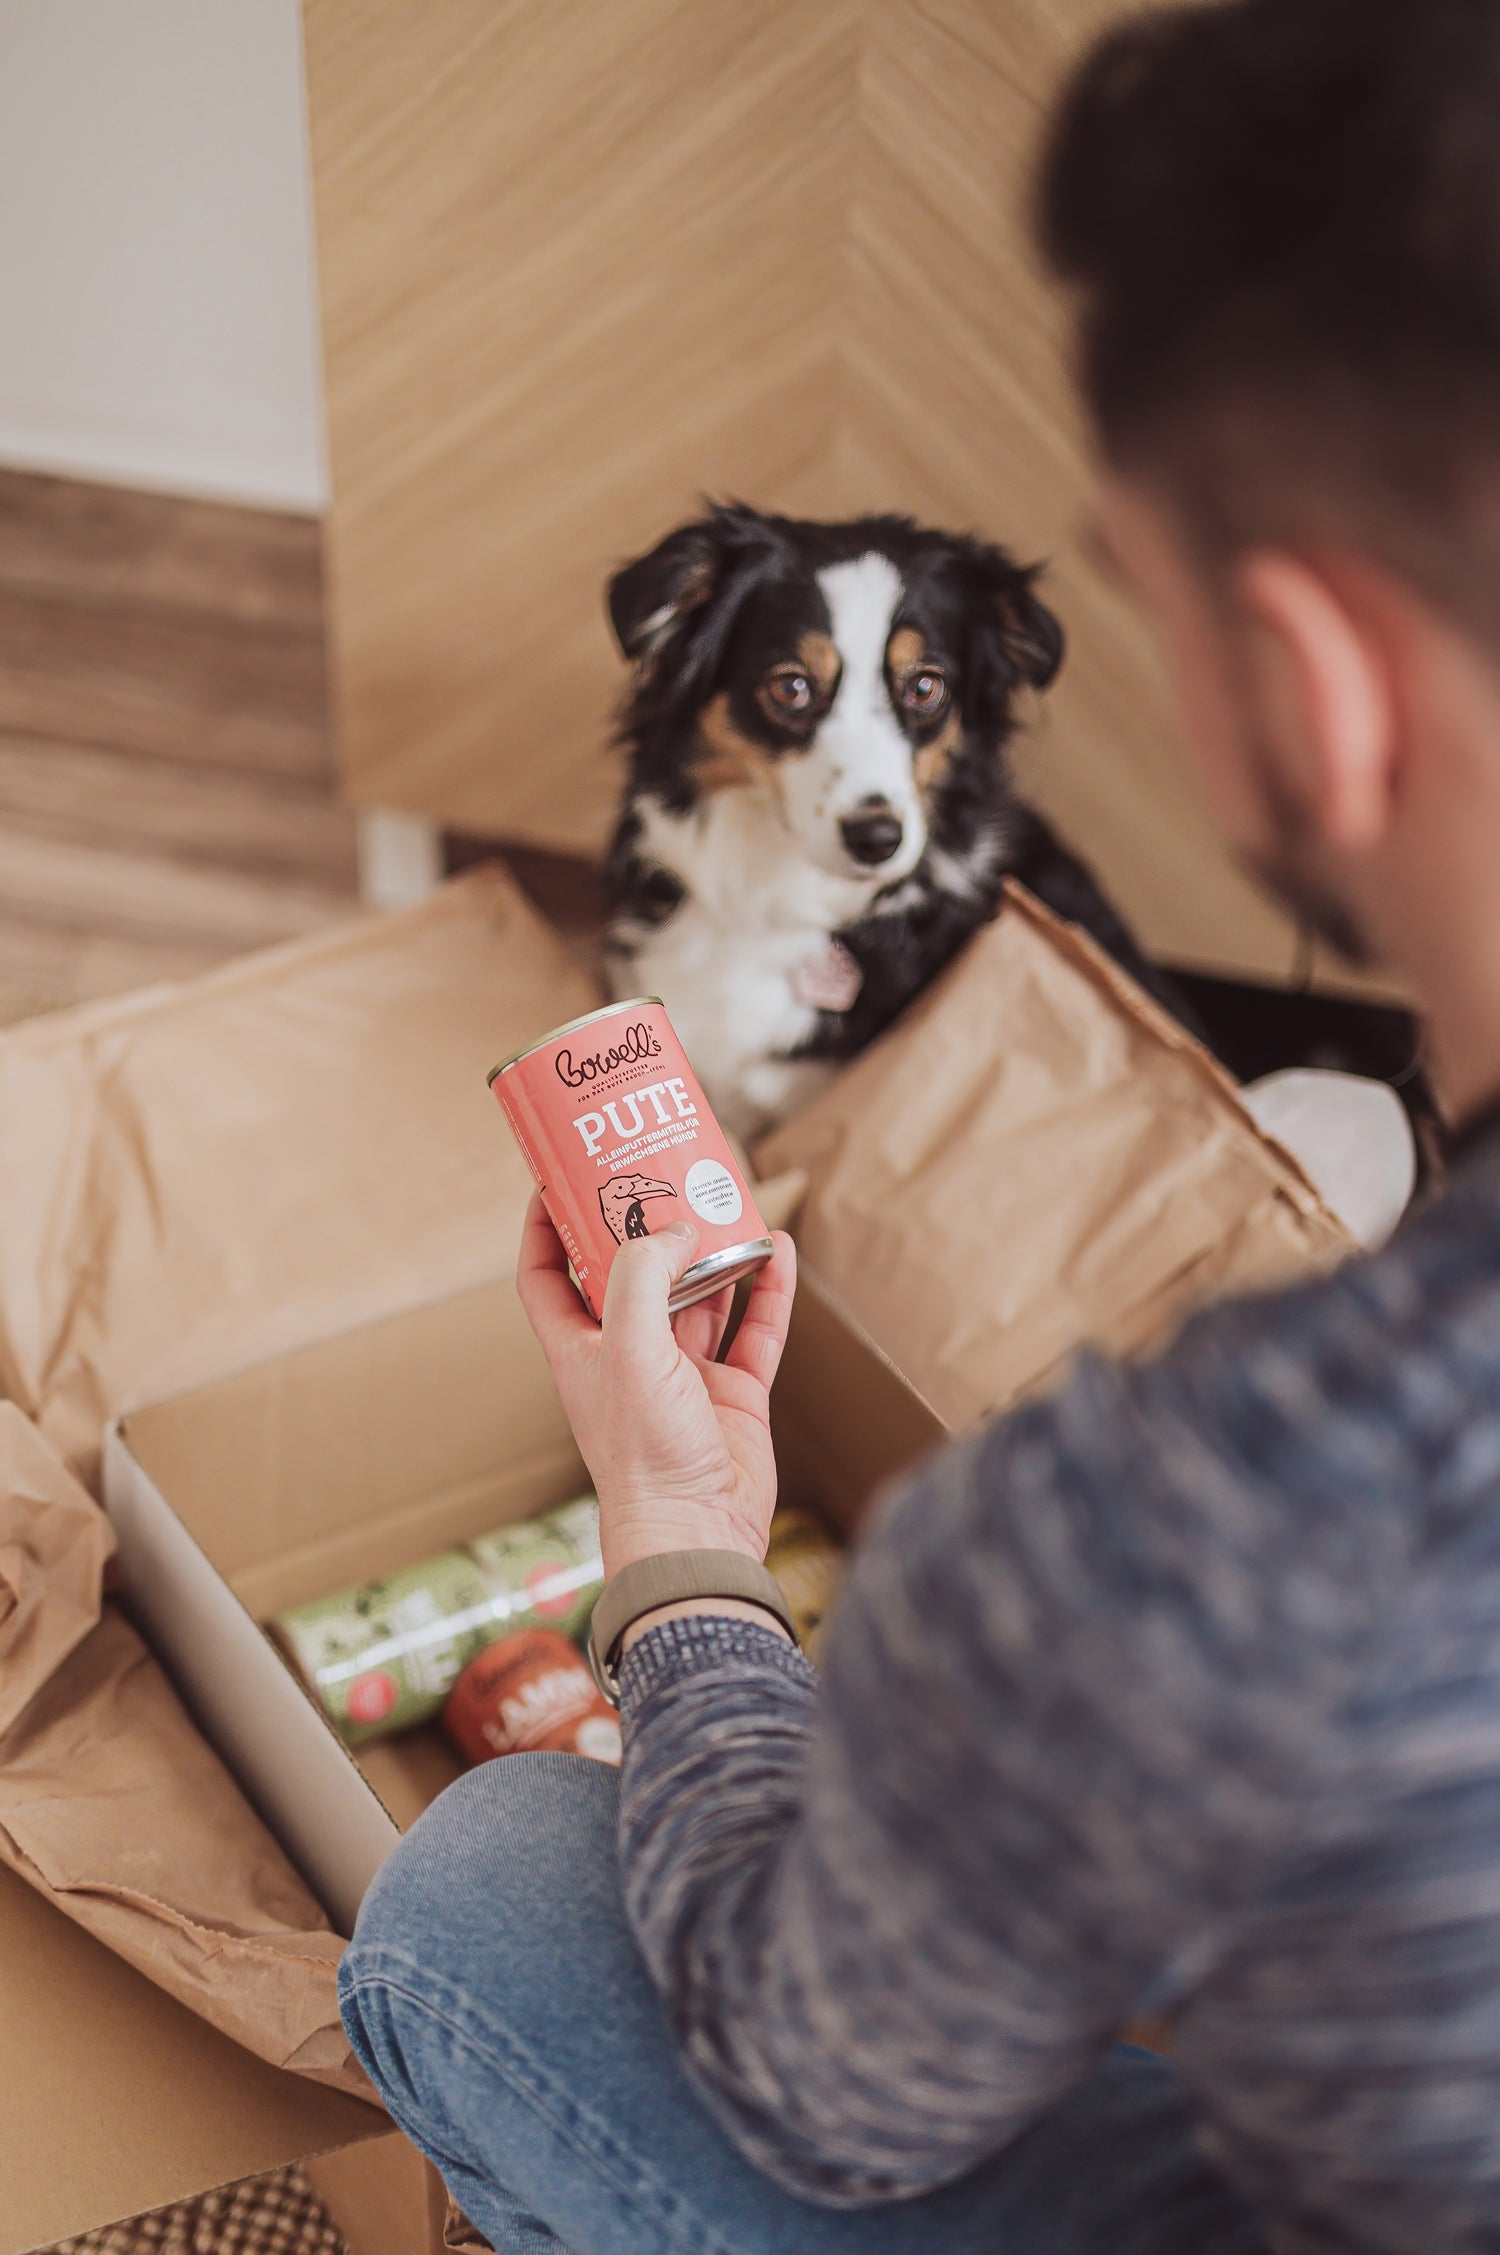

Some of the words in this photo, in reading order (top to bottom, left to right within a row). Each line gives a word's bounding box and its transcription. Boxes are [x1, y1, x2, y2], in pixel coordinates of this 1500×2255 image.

[572, 1077, 697, 1158] PUTE
[595, 1122, 686, 1168] ALLEINFUTTERMITTEL
[685, 1117, 700, 1130] FÜR
[609, 1139, 671, 1172] ERWACHSENE
[669, 1129, 698, 1146] HUNDE
